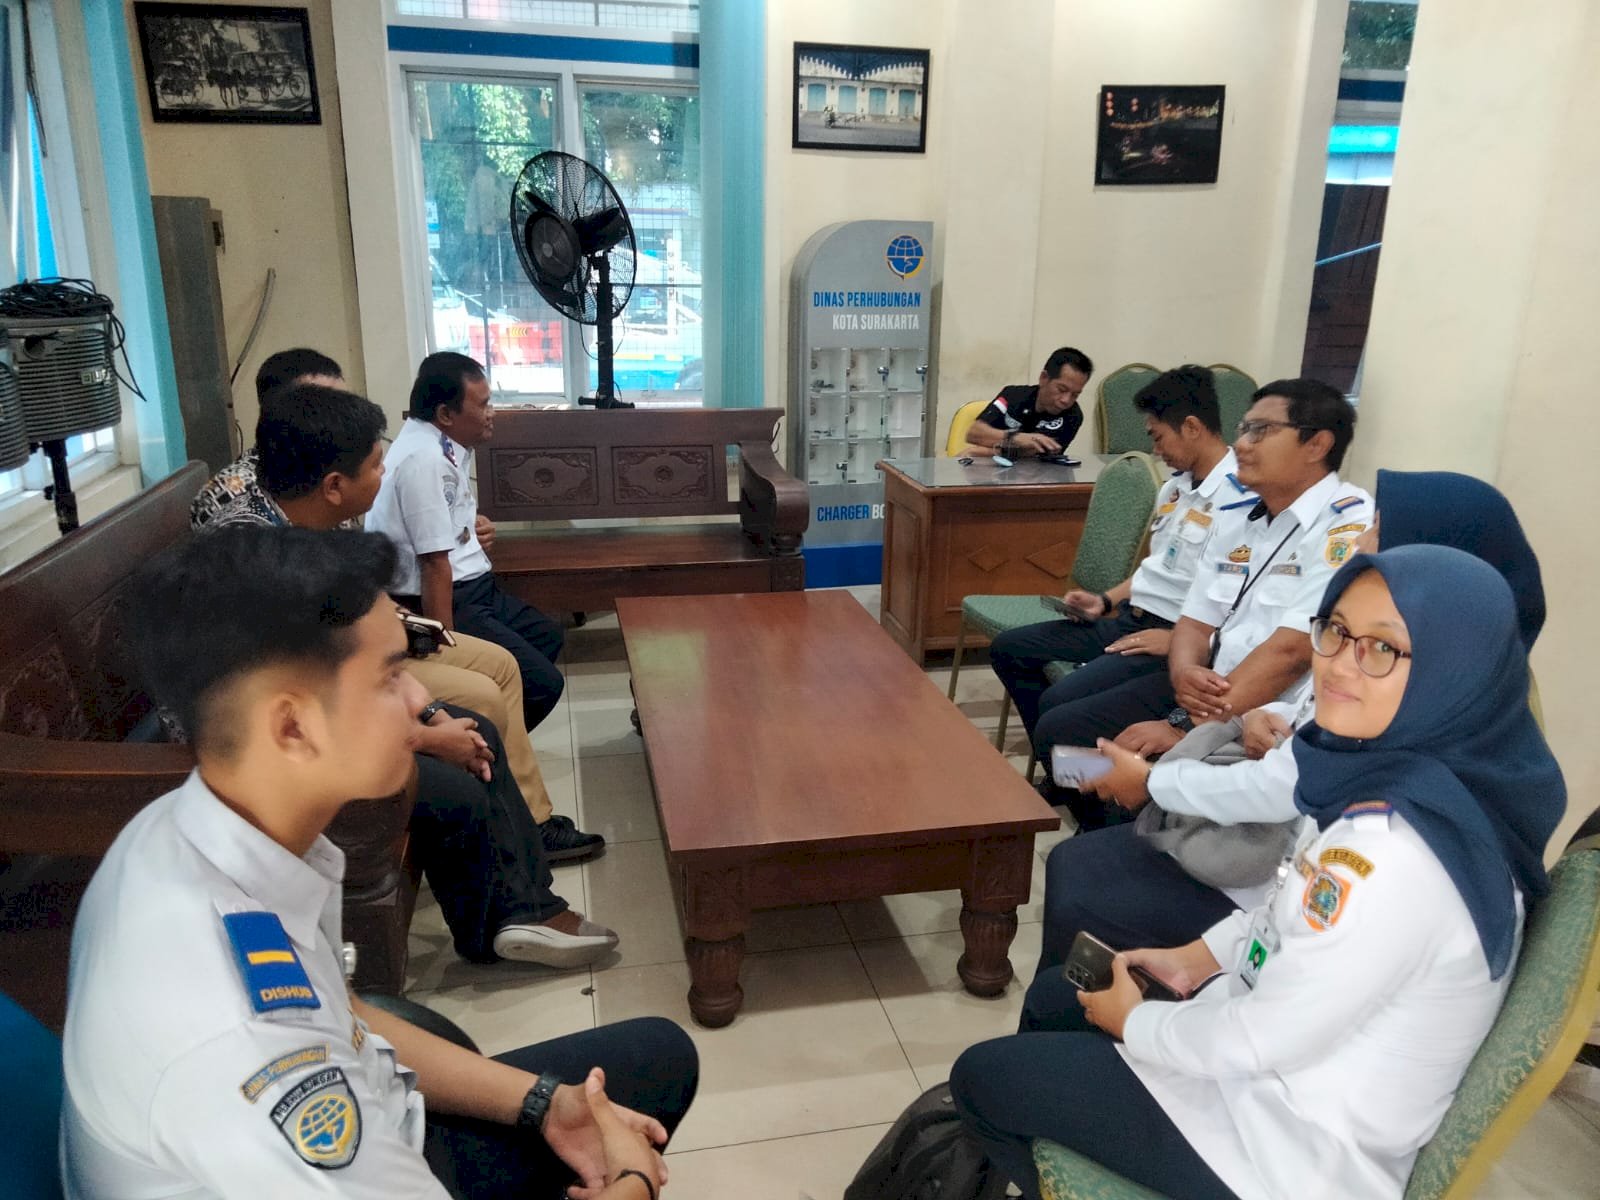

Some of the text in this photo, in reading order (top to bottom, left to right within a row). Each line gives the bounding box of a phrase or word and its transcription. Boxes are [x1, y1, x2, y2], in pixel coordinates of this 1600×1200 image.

[813, 291, 921, 307] DINAS PERHUBUNGAN
[832, 314, 919, 330] KOTA SURAKARTA
[817, 504, 869, 521] CHARGER
[260, 986, 312, 1002] DISHUB
